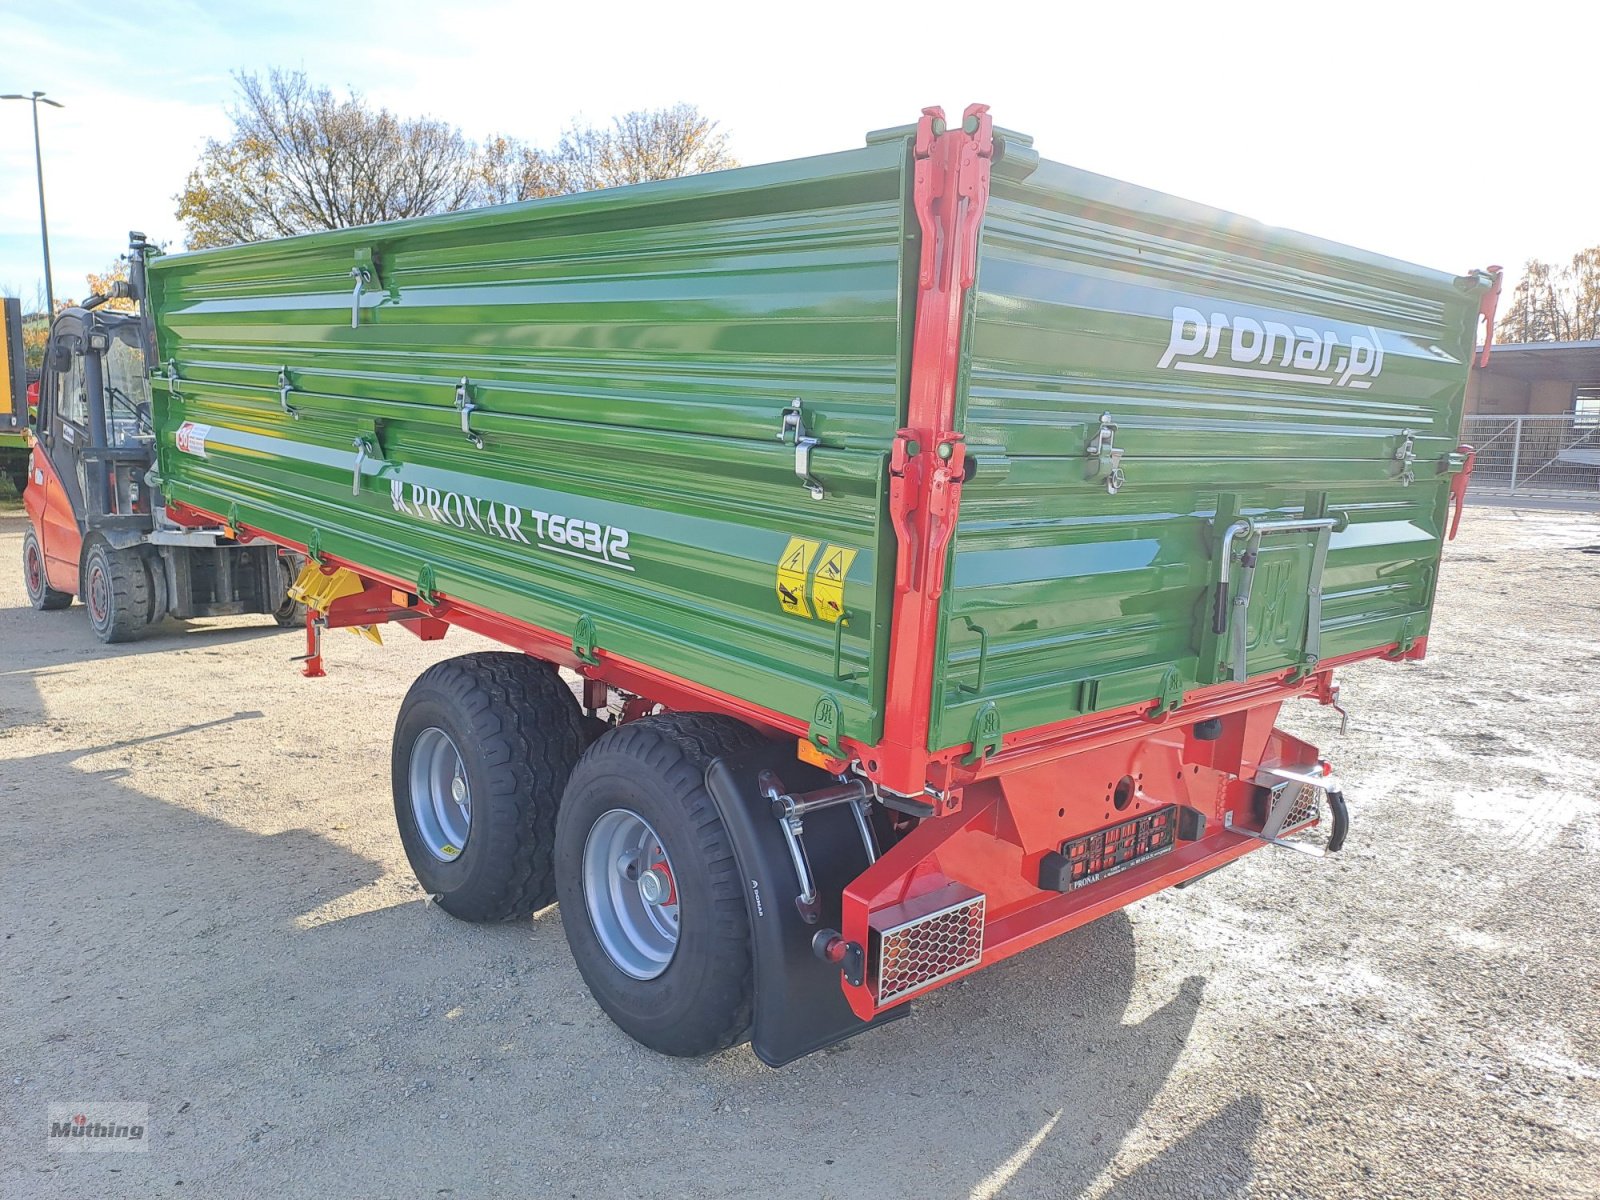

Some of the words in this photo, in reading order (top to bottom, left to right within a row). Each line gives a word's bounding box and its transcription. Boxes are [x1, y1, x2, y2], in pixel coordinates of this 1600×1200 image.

[1156, 306, 1385, 387] pronar.pl
[411, 484, 532, 545] PRONAR
[532, 509, 632, 561] T663/2
[753, 889, 764, 917] DOMAR
[1074, 873, 1100, 889] PRONAR
